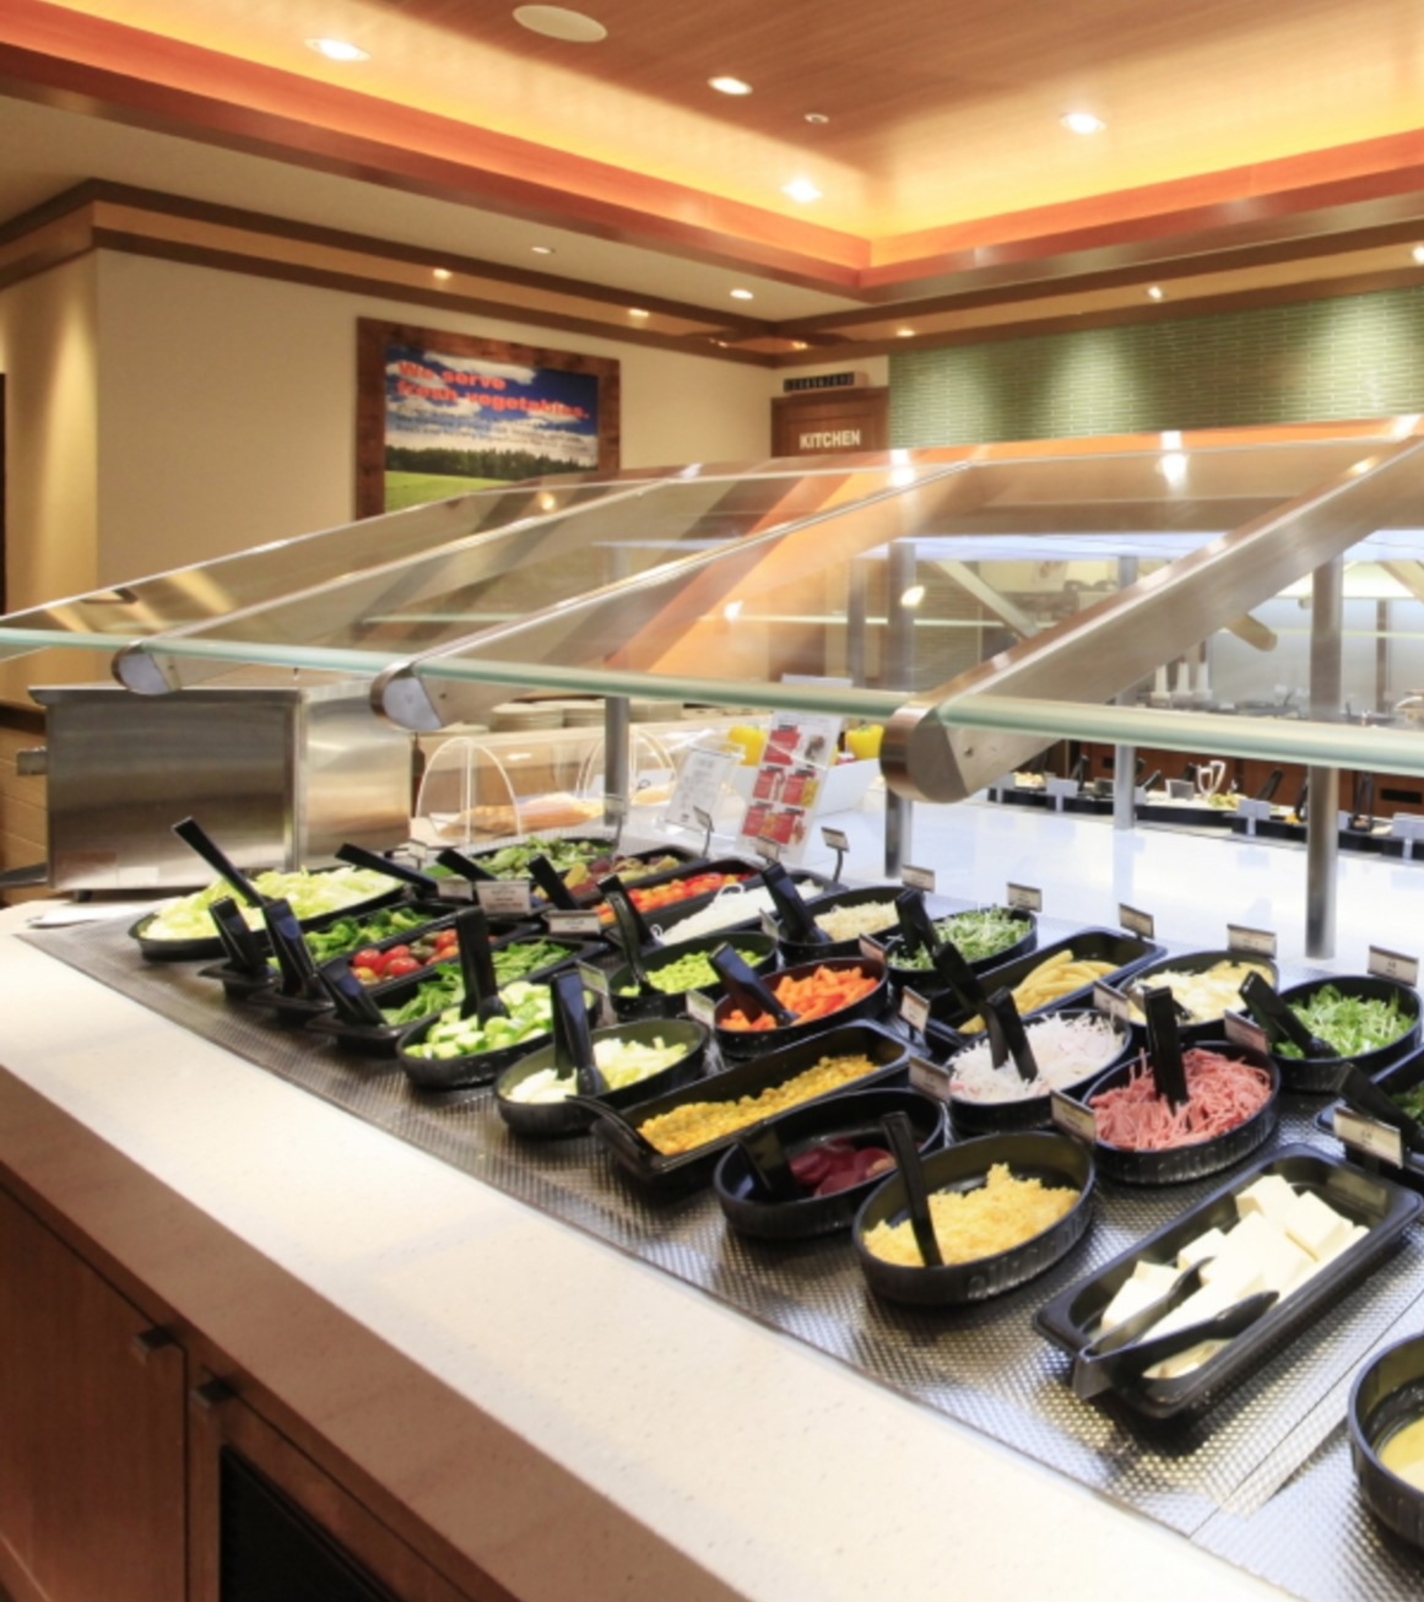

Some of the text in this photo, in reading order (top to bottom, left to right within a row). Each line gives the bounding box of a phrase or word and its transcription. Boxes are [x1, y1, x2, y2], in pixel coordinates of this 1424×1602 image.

[397, 361, 506, 390] We serve
[396, 380, 458, 402] fresh
[799, 429, 861, 451] KITCHEN
